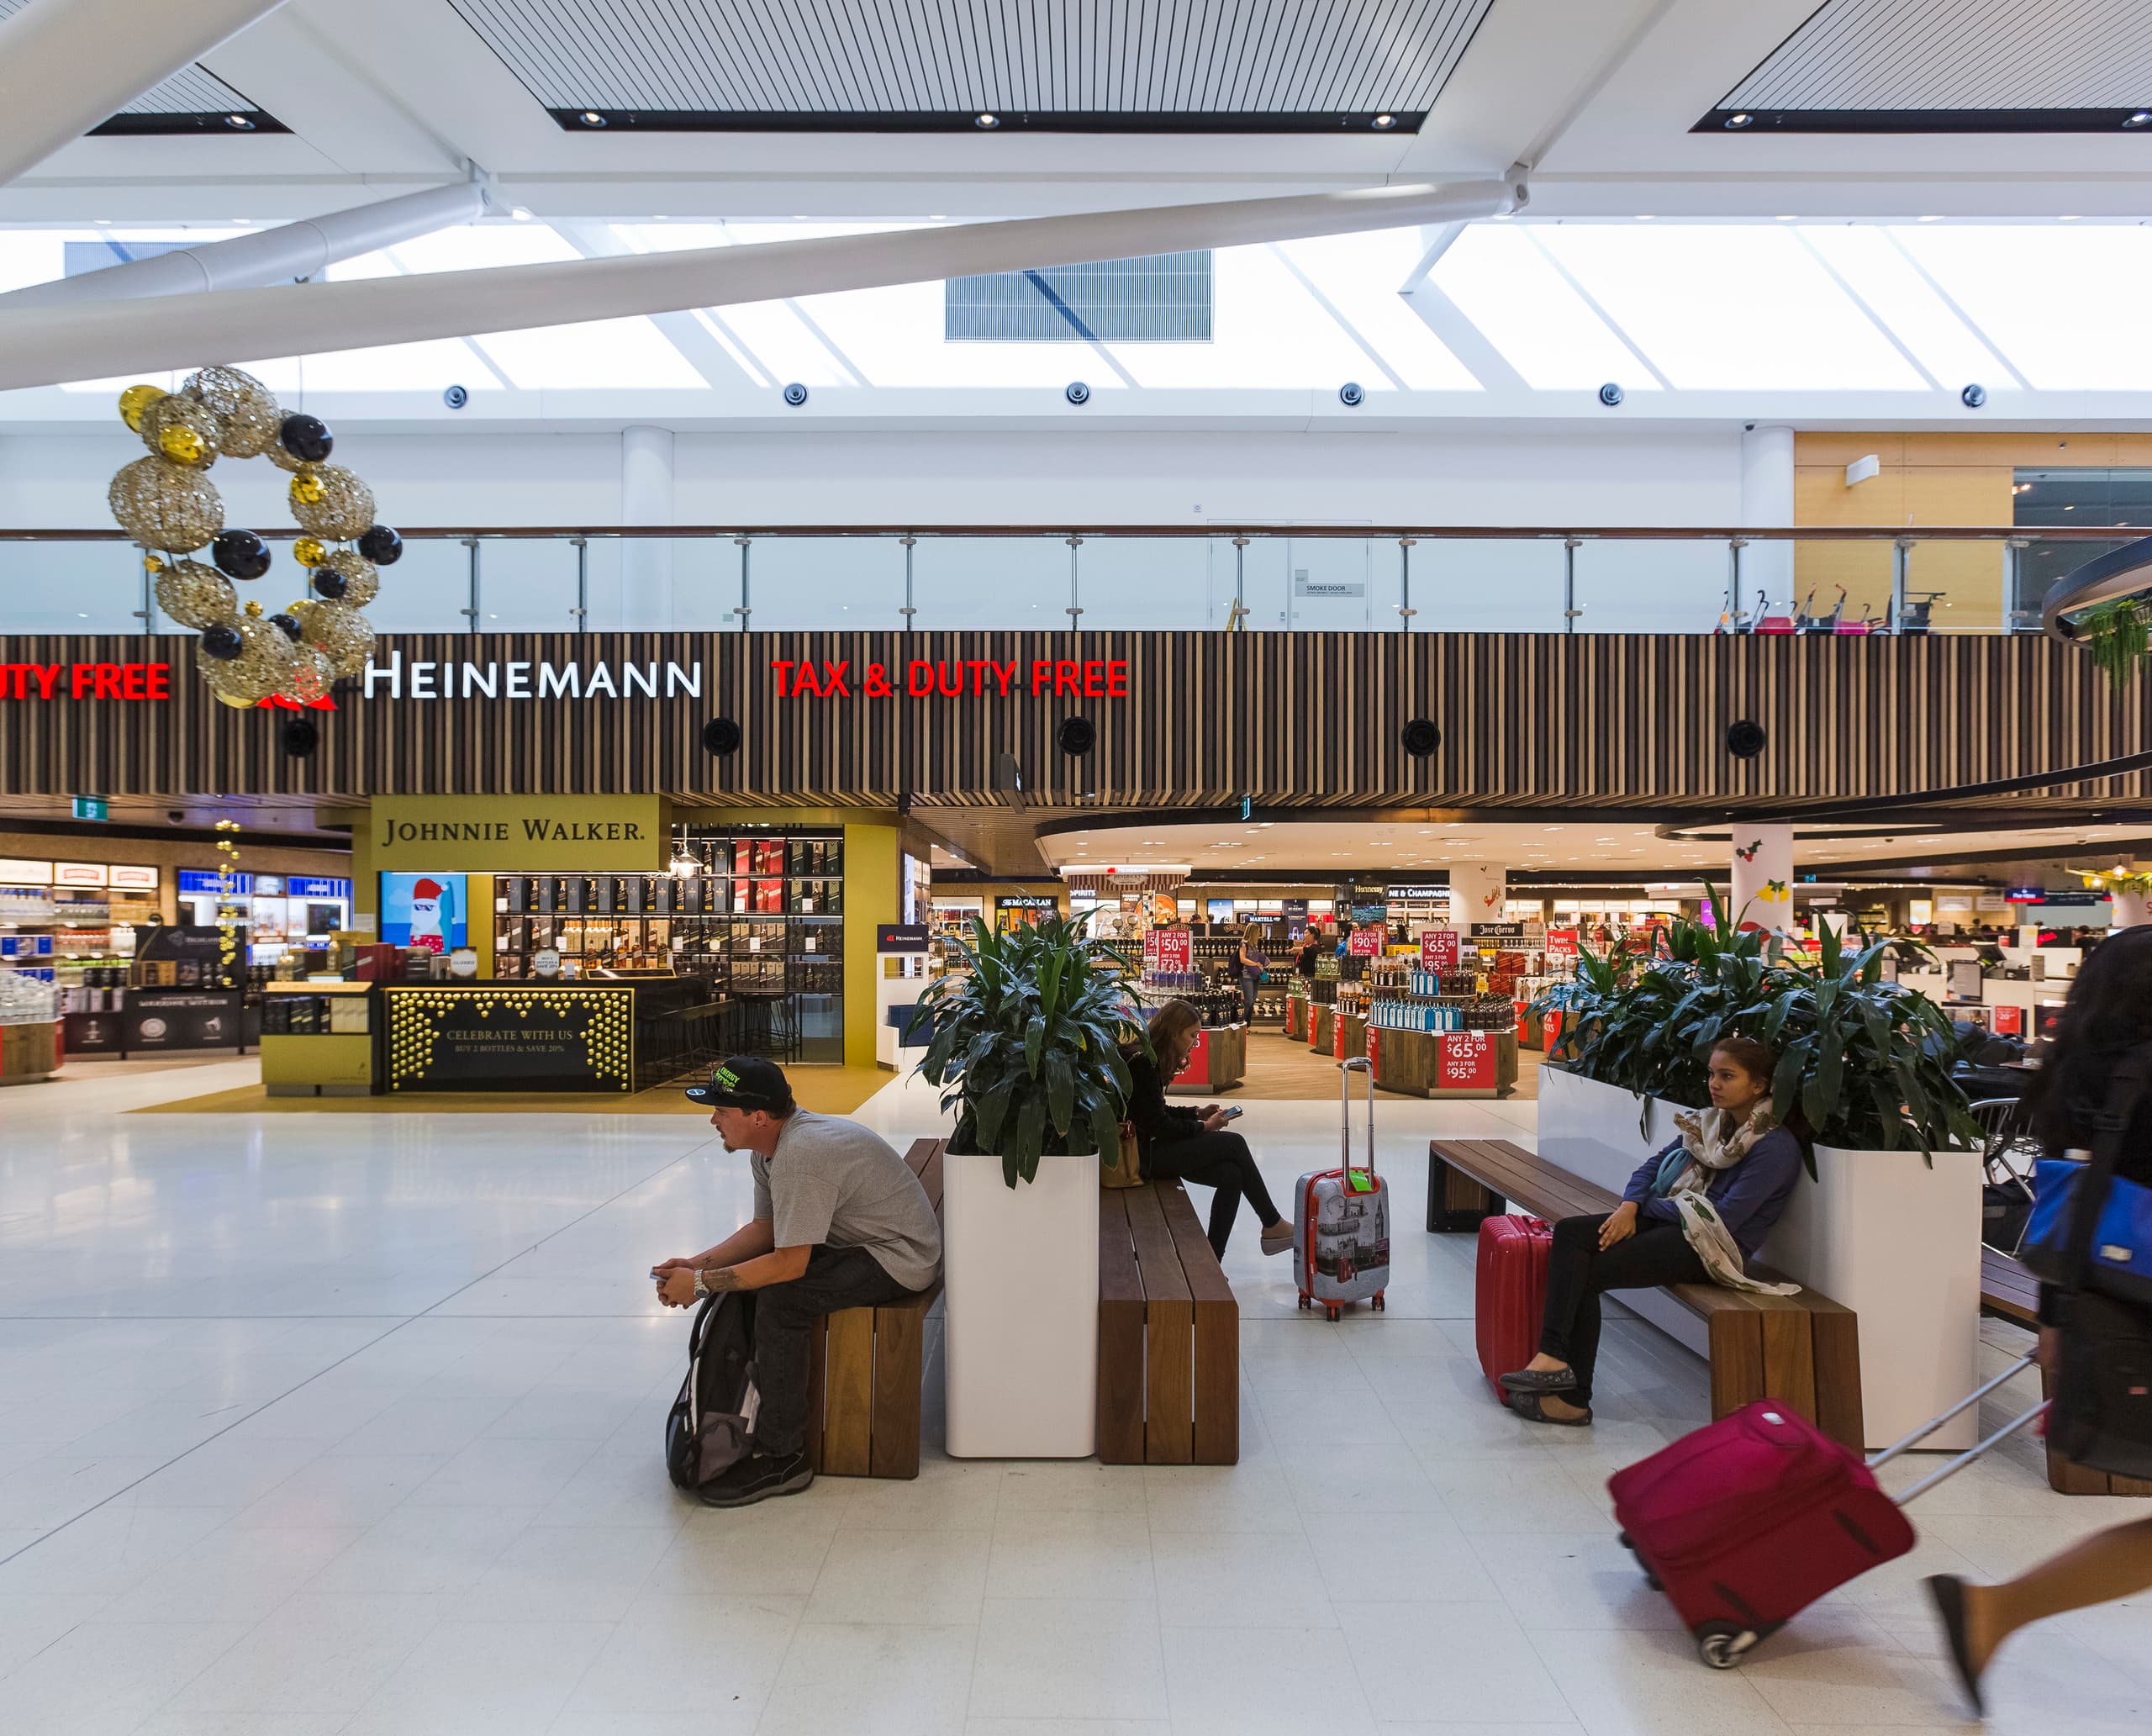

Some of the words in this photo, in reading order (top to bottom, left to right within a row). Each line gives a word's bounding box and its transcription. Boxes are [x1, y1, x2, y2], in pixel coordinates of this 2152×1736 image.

[0, 663, 61, 699] TY
[71, 662, 170, 699] FREE
[771, 661, 850, 698] TAX
[863, 662, 893, 698] &
[908, 660, 1017, 698] DUTY
[1032, 660, 1128, 698] FREE
[382, 819, 509, 847] JOHNNIE
[1161, 938, 1188, 952] $50.00
[1353, 937, 1378, 947] $90.00
[1425, 940, 1455, 952] $65.00
[1549, 945, 1571, 953] PACKS
[446, 1031, 517, 1040] CELEBRATE
[521, 1031, 554, 1040] WITH
[558, 1031, 572, 1040] US
[1447, 1043, 1486, 1058] $65.00
[1447, 1068, 1476, 1079] $95.00
